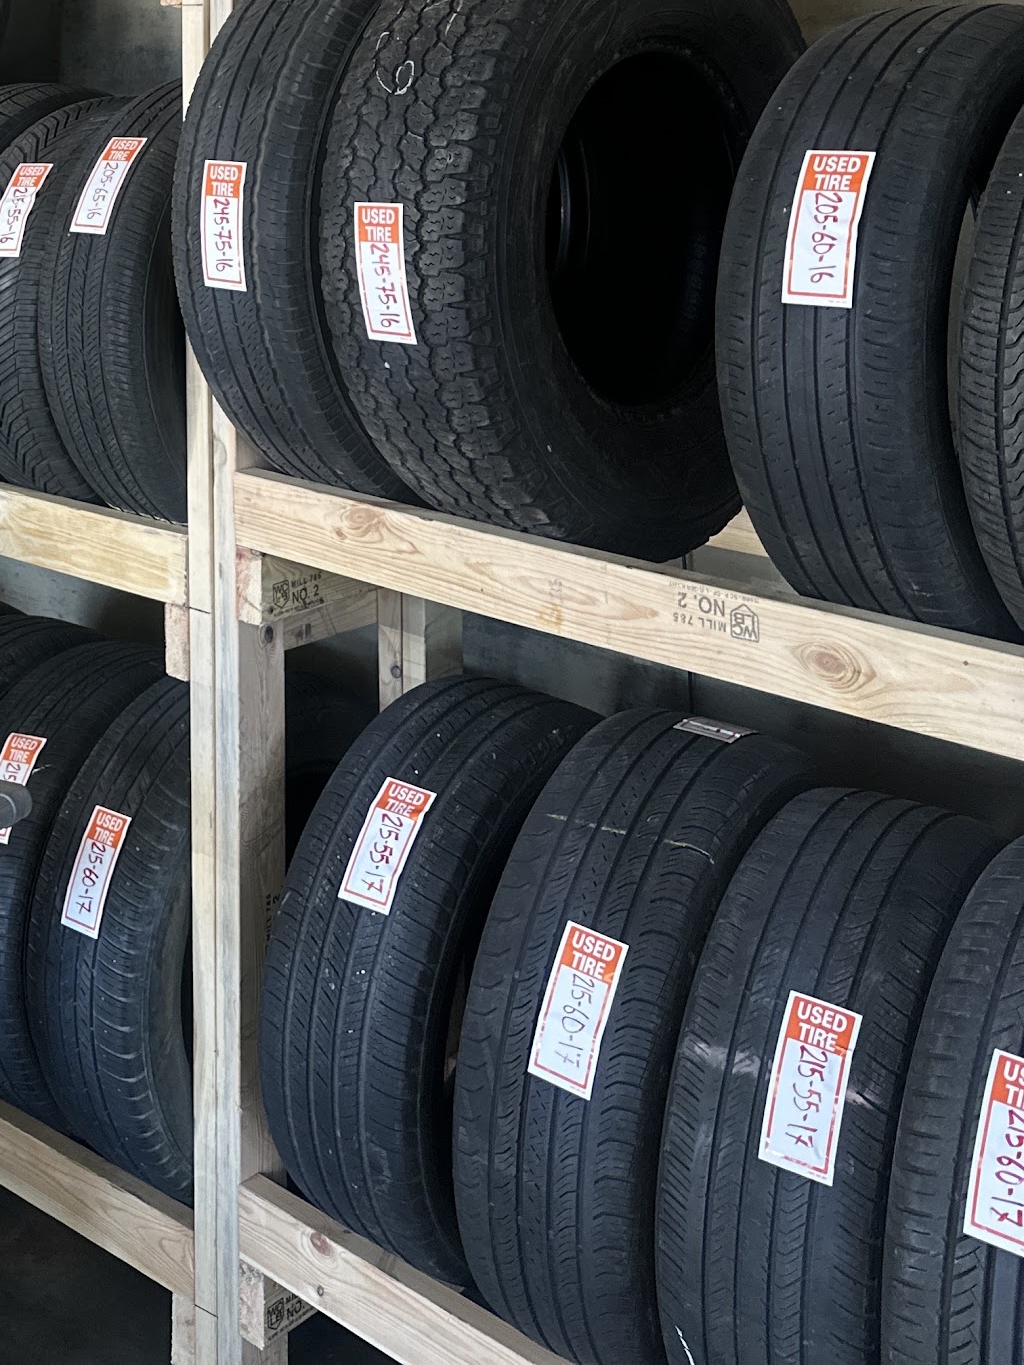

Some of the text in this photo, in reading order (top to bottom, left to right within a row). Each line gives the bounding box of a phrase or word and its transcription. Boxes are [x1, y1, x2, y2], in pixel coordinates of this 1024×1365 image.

[112, 140, 138, 150] USED
[109, 150, 131, 161] TIRE
[812, 156, 861, 173] USED
[19, 165, 44, 176] USED
[210, 166, 239, 180] USED
[17, 176, 37, 187] TIRE
[87, 162, 118, 219] 205-65-16
[211, 182, 234, 196] TIRE
[814, 174, 852, 191] TIRE
[362, 209, 395, 224] USED
[213, 198, 233, 273] 245-75-16
[365, 226, 392, 242] TIRE
[809, 192, 843, 284] 205-60-16
[370, 244, 400, 328] 245-75-16
[694, 594, 726, 617] NO.
[698, 617, 727, 633] MILL
[11, 736, 38, 751] USED
[9, 748, 31, 763] TIRE
[388, 784, 426, 806] USED
[385, 798, 416, 817] TIRE
[96, 811, 123, 832] USED
[93, 827, 115, 846] TIRE
[75, 841, 106, 915] 215-60-17
[571, 931, 615, 962] USED
[571, 950, 607, 980] TIRE
[554, 973, 596, 1068] 215-60-17
[797, 1001, 848, 1033] USED
[799, 1022, 839, 1052] TIRE
[785, 1044, 828, 1148] 215-55-17
